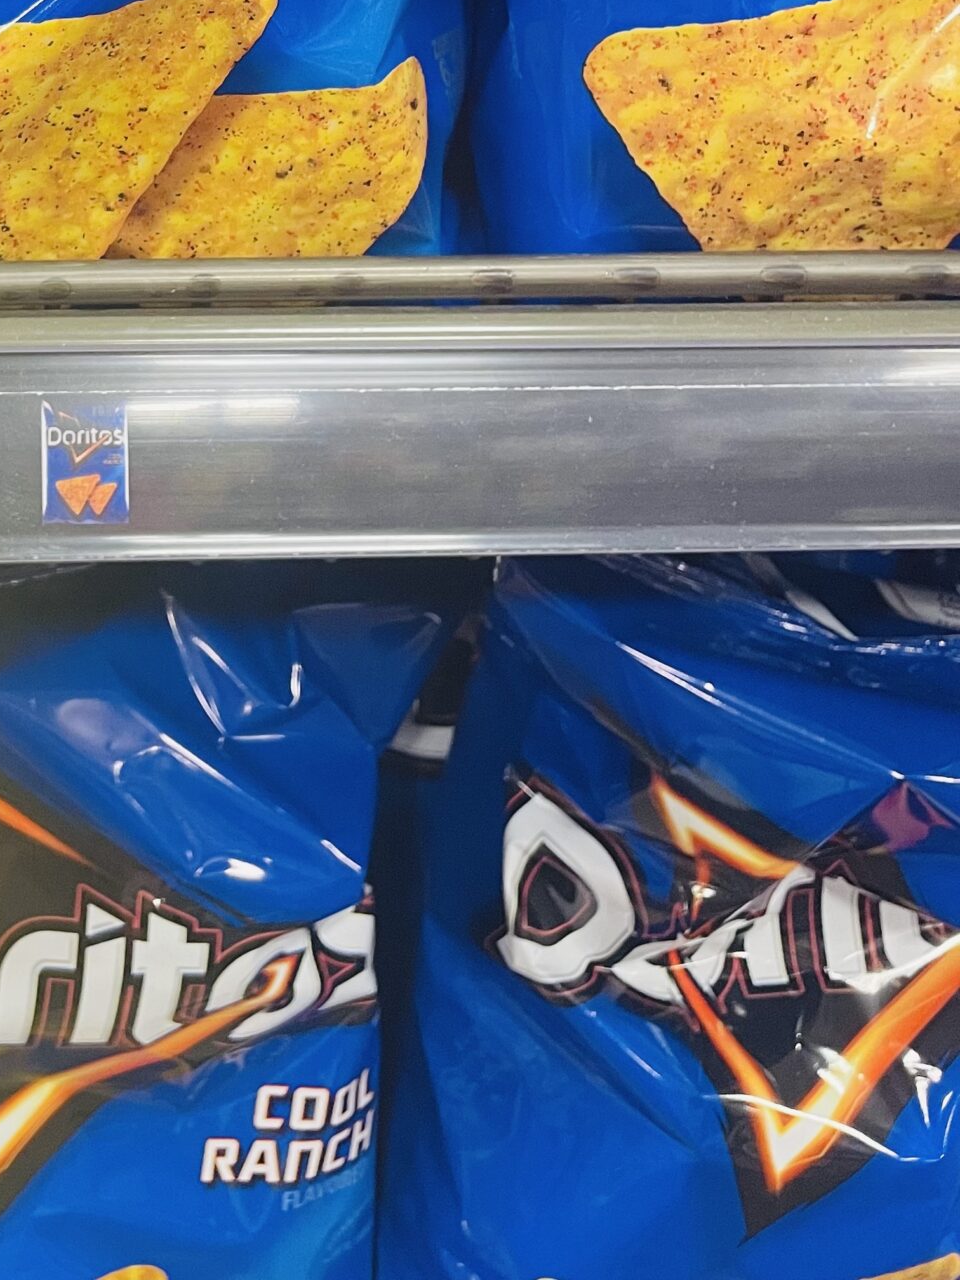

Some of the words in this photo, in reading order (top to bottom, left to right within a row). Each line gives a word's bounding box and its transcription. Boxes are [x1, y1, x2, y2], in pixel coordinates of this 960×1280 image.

[47, 426, 123, 446] Doritos
[253, 1067, 374, 1131] COOL
[200, 1108, 374, 1184] RANCH
